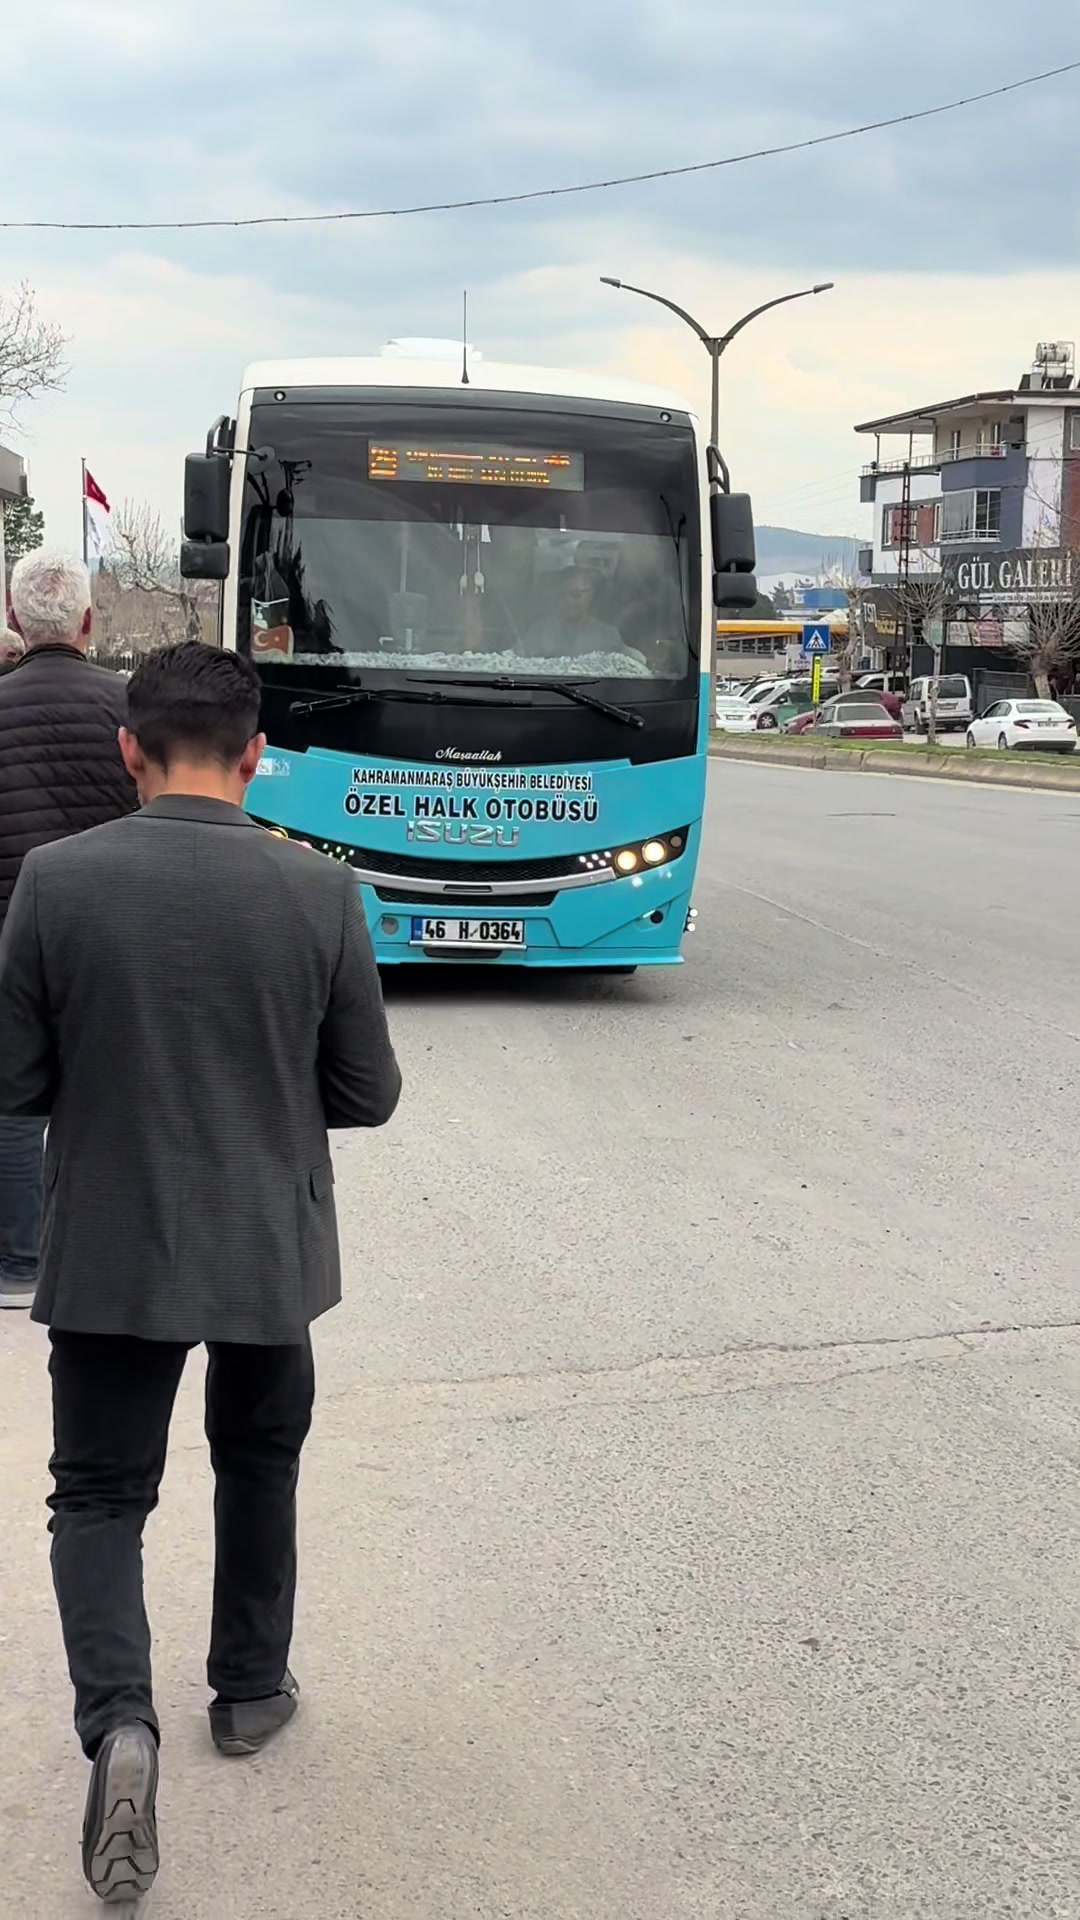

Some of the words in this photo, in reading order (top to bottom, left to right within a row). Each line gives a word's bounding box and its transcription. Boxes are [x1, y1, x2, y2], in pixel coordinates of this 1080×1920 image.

[958, 556, 994, 589] GÜL
[435, 747, 502, 762] Maşaallah
[353, 768, 453, 791] KAHRAMANMARAŞ
[456, 767, 527, 793] BÜYÜKŞEHİR
[529, 771, 592, 792] BELEDİYESİ
[345, 788, 406, 817] ÖZEL
[415, 796, 478, 819] HALK
[486, 794, 598, 822] OTOBÜSÜ
[406, 820, 520, 847] ISUZU
[425, 920, 446, 939] 46
[459, 921, 470, 940] H
[480, 922, 520, 941] 0364
